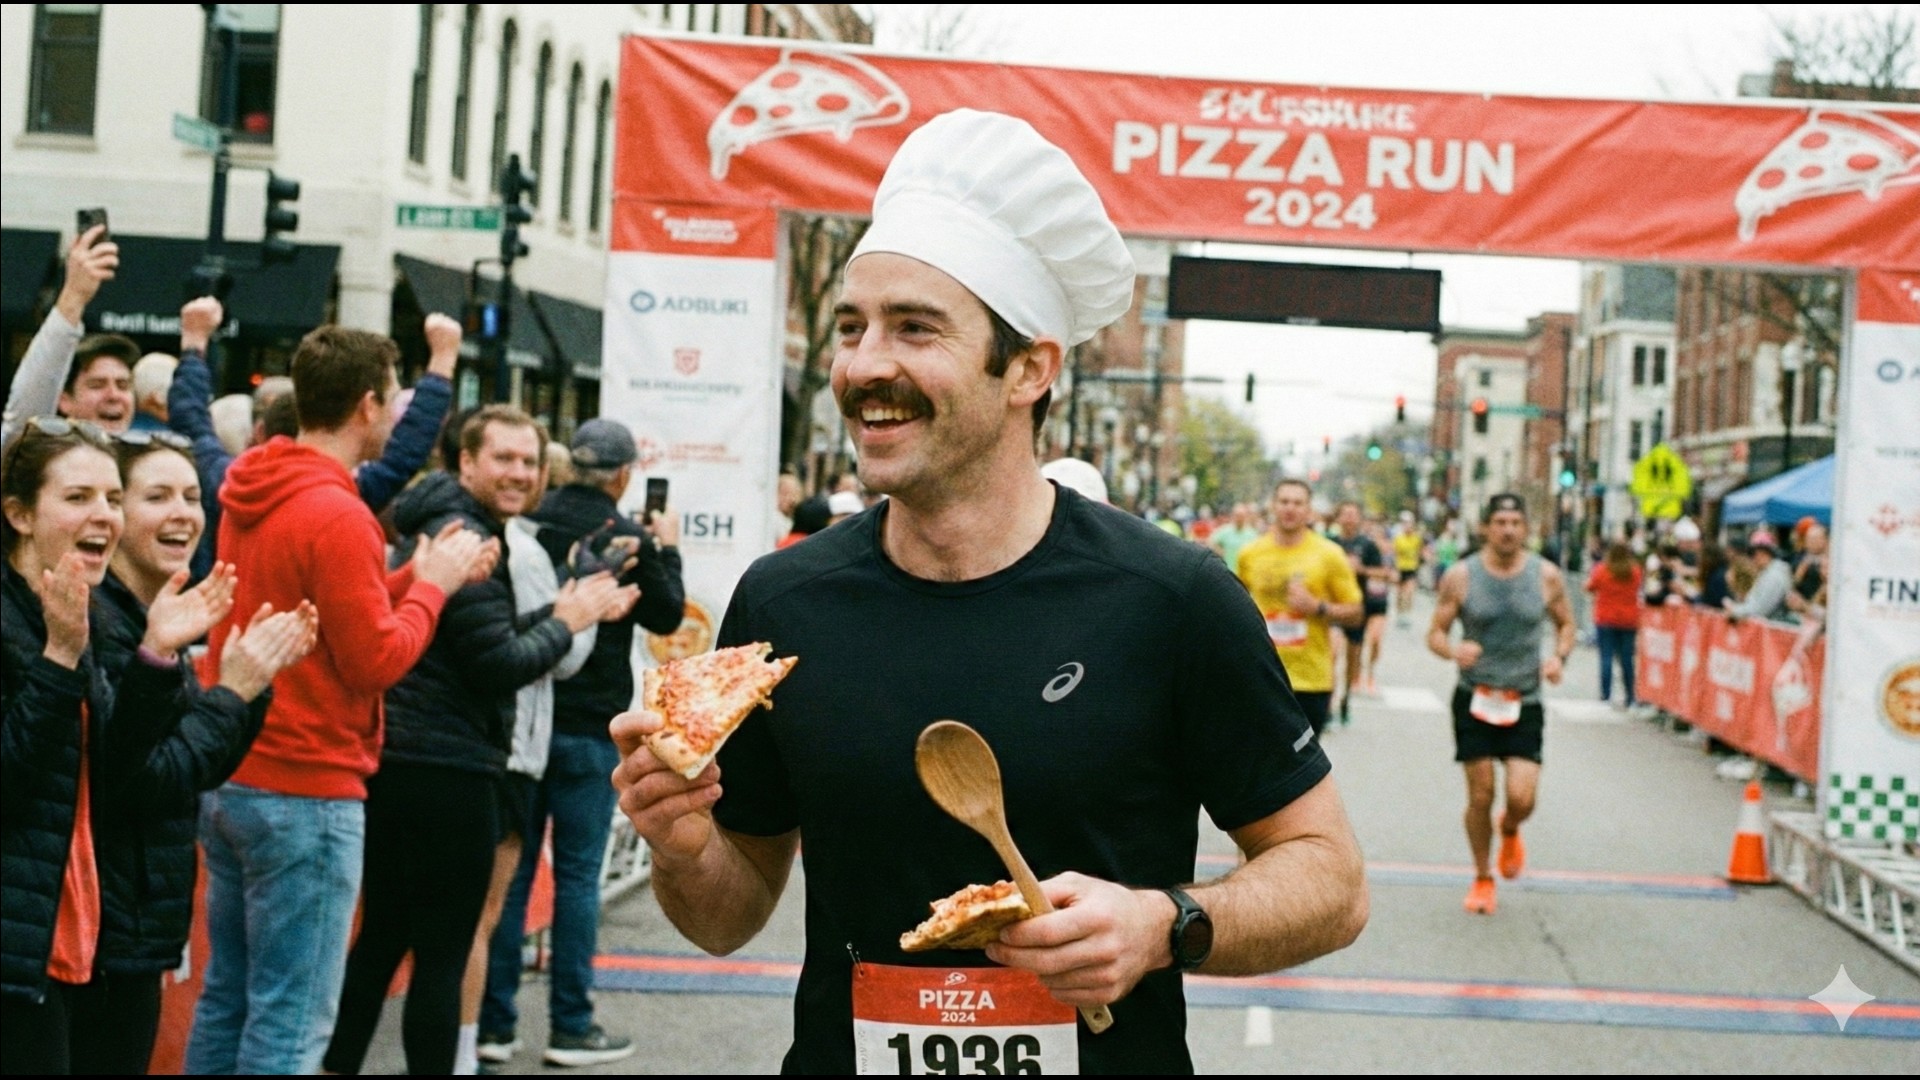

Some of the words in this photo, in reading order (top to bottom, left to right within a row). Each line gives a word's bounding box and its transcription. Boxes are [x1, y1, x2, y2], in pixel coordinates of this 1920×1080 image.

[1112, 121, 1343, 185] PIZZA
[1366, 136, 1515, 195] RUN
[1244, 188, 1377, 230] 2024
[1869, 578, 1919, 602] FIN
[919, 989, 996, 1010] PIZZA
[941, 1011, 976, 1023] 2024
[887, 1033, 1042, 1075] 1936
